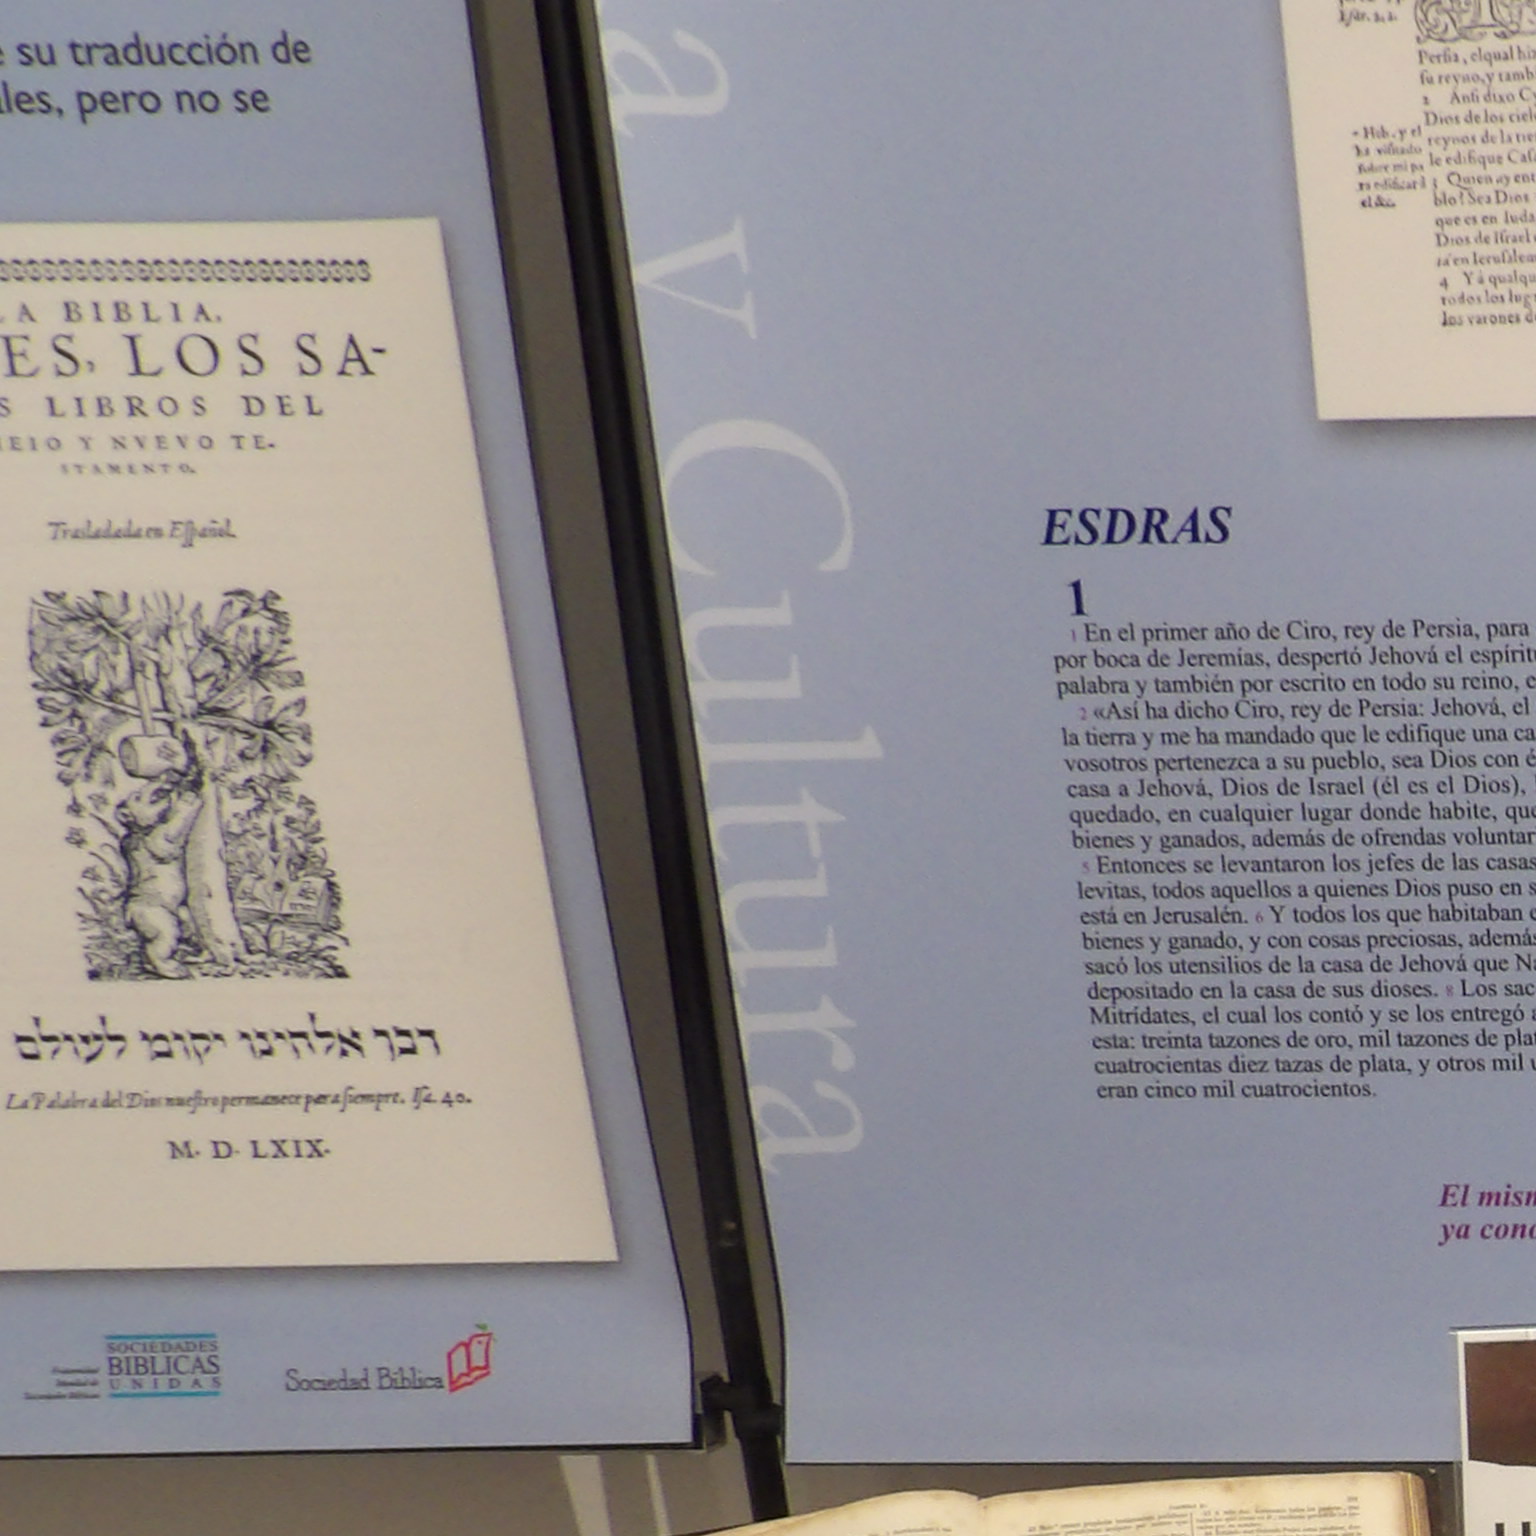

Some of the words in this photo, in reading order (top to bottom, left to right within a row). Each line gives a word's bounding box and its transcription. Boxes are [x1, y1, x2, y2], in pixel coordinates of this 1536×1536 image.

[15, 42, 58, 68] su
[66, 31, 260, 68] traducción
[270, 29, 312, 65] de
[0, 79, 65, 119] les,
[74, 89, 163, 126] pero
[174, 89, 222, 115] no
[231, 88, 271, 115] se
[62, 300, 223, 324] BIBLIA.
[0, 333, 96, 378] ES,
[121, 332, 266, 378] LOS
[294, 332, 387, 377] SA-
[44, 394, 208, 418] LIBROS
[239, 394, 324, 417] DEL
[1039, 505, 1233, 547] ESDRAS
[1068, 578, 1088, 617] 1
[662, 420, 884, 1177] Cultura
[1095, 1084, 1139, 1099] eran
[1143, 1079, 1198, 1099] cinco
[1201, 1078, 1236, 1099] mil
[1240, 1077, 1378, 1099] cuatrocientos.
[1437, 1183, 1470, 1208] El
[1437, 1223, 1471, 1247] ya
[106, 1341, 218, 1353] SOCIEDADES
[107, 1355, 221, 1376] BIBLICAS
[284, 1367, 373, 1393] Sociedad
[375, 1365, 444, 1391] Bíblica
